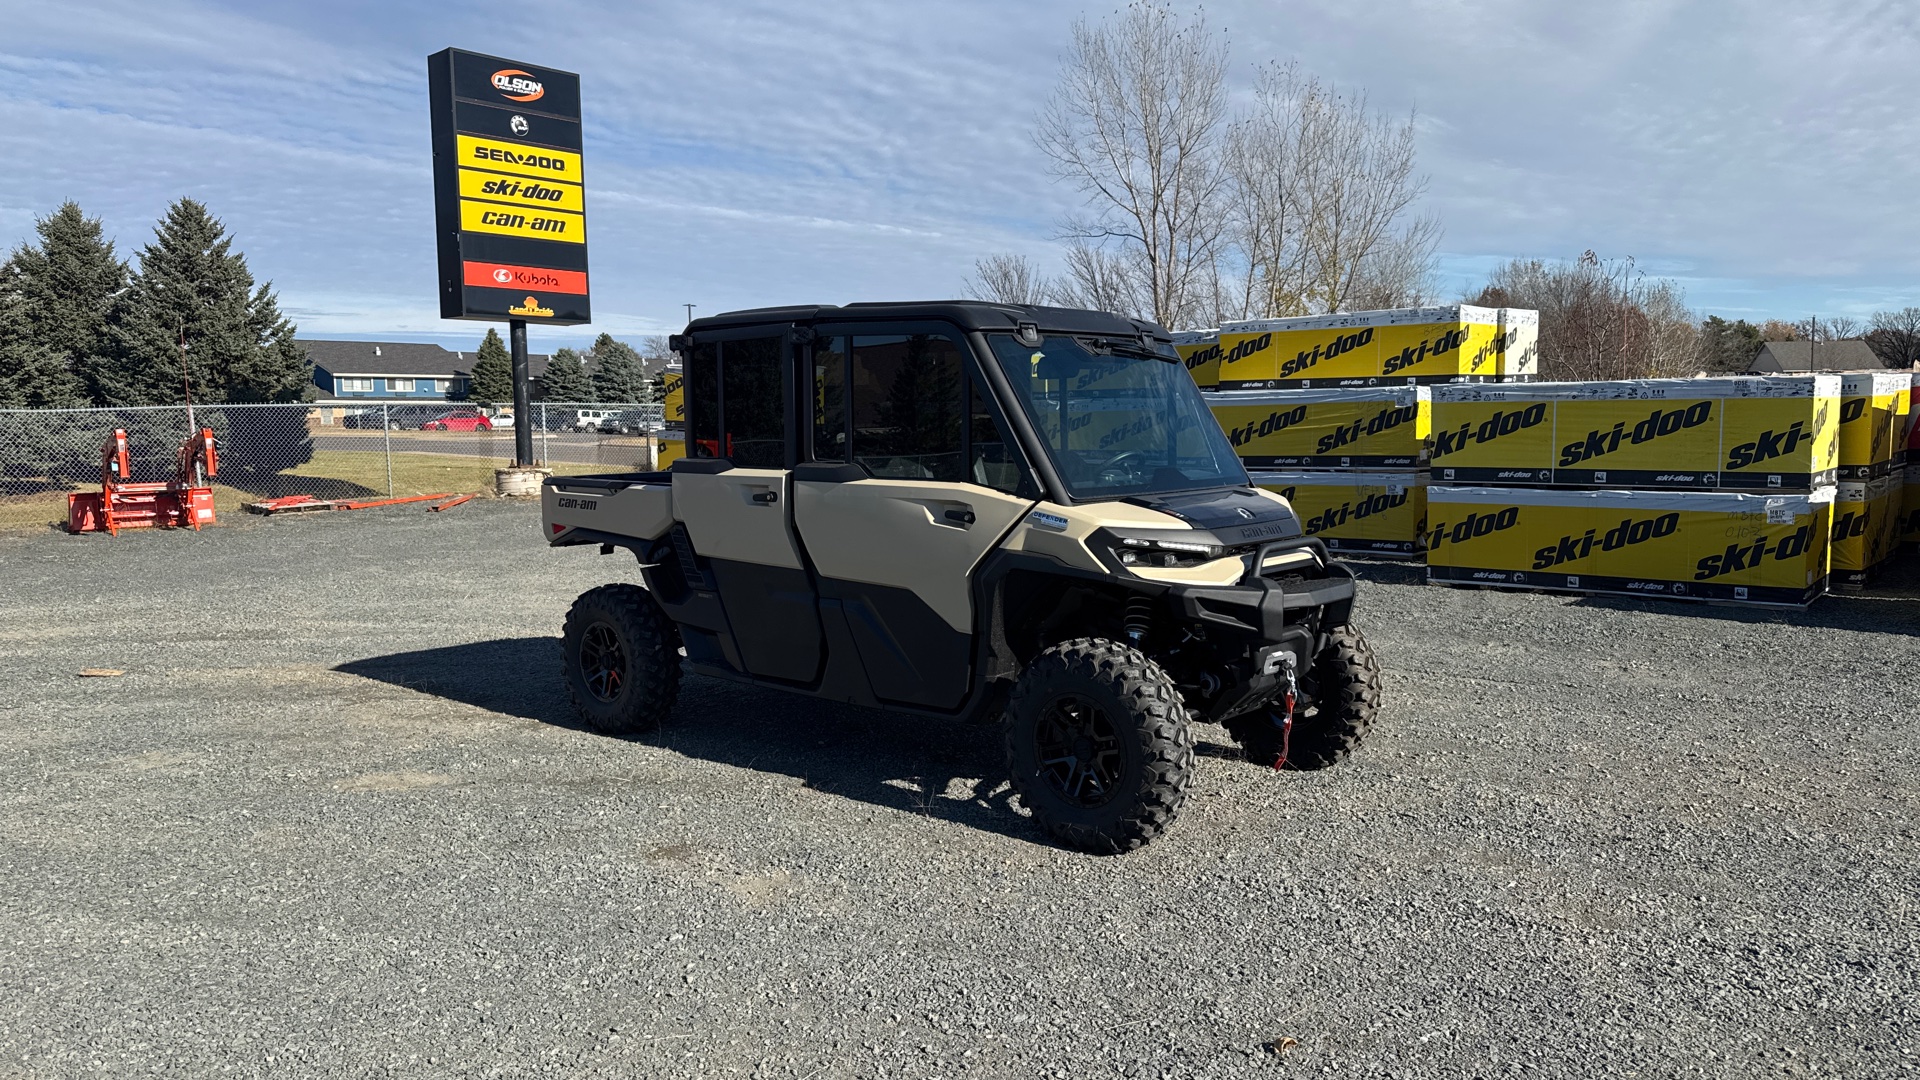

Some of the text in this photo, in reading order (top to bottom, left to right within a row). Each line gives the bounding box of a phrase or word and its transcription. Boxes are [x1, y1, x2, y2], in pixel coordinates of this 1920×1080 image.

[494, 75, 542, 92] OLSON
[481, 180, 563, 202] ski-doo
[481, 211, 566, 233] can-am
[515, 272, 559, 286] Kubota
[1219, 332, 1272, 368] i-doo
[1280, 327, 1374, 378] ski-doo
[1382, 324, 1470, 375] ski-doo
[1229, 405, 1307, 449] ki-doo
[1559, 401, 1713, 467] ski-doo
[1655, 474, 1695, 482] ski-doo
[558, 497, 598, 511] can-am
[1033, 511, 1068, 524] DEFENDER
[1241, 523, 1283, 539] can-am
[1532, 512, 1680, 570] ski-doo
[1472, 571, 1506, 579] ski-doo
[1626, 581, 1664, 590] ski-doo
